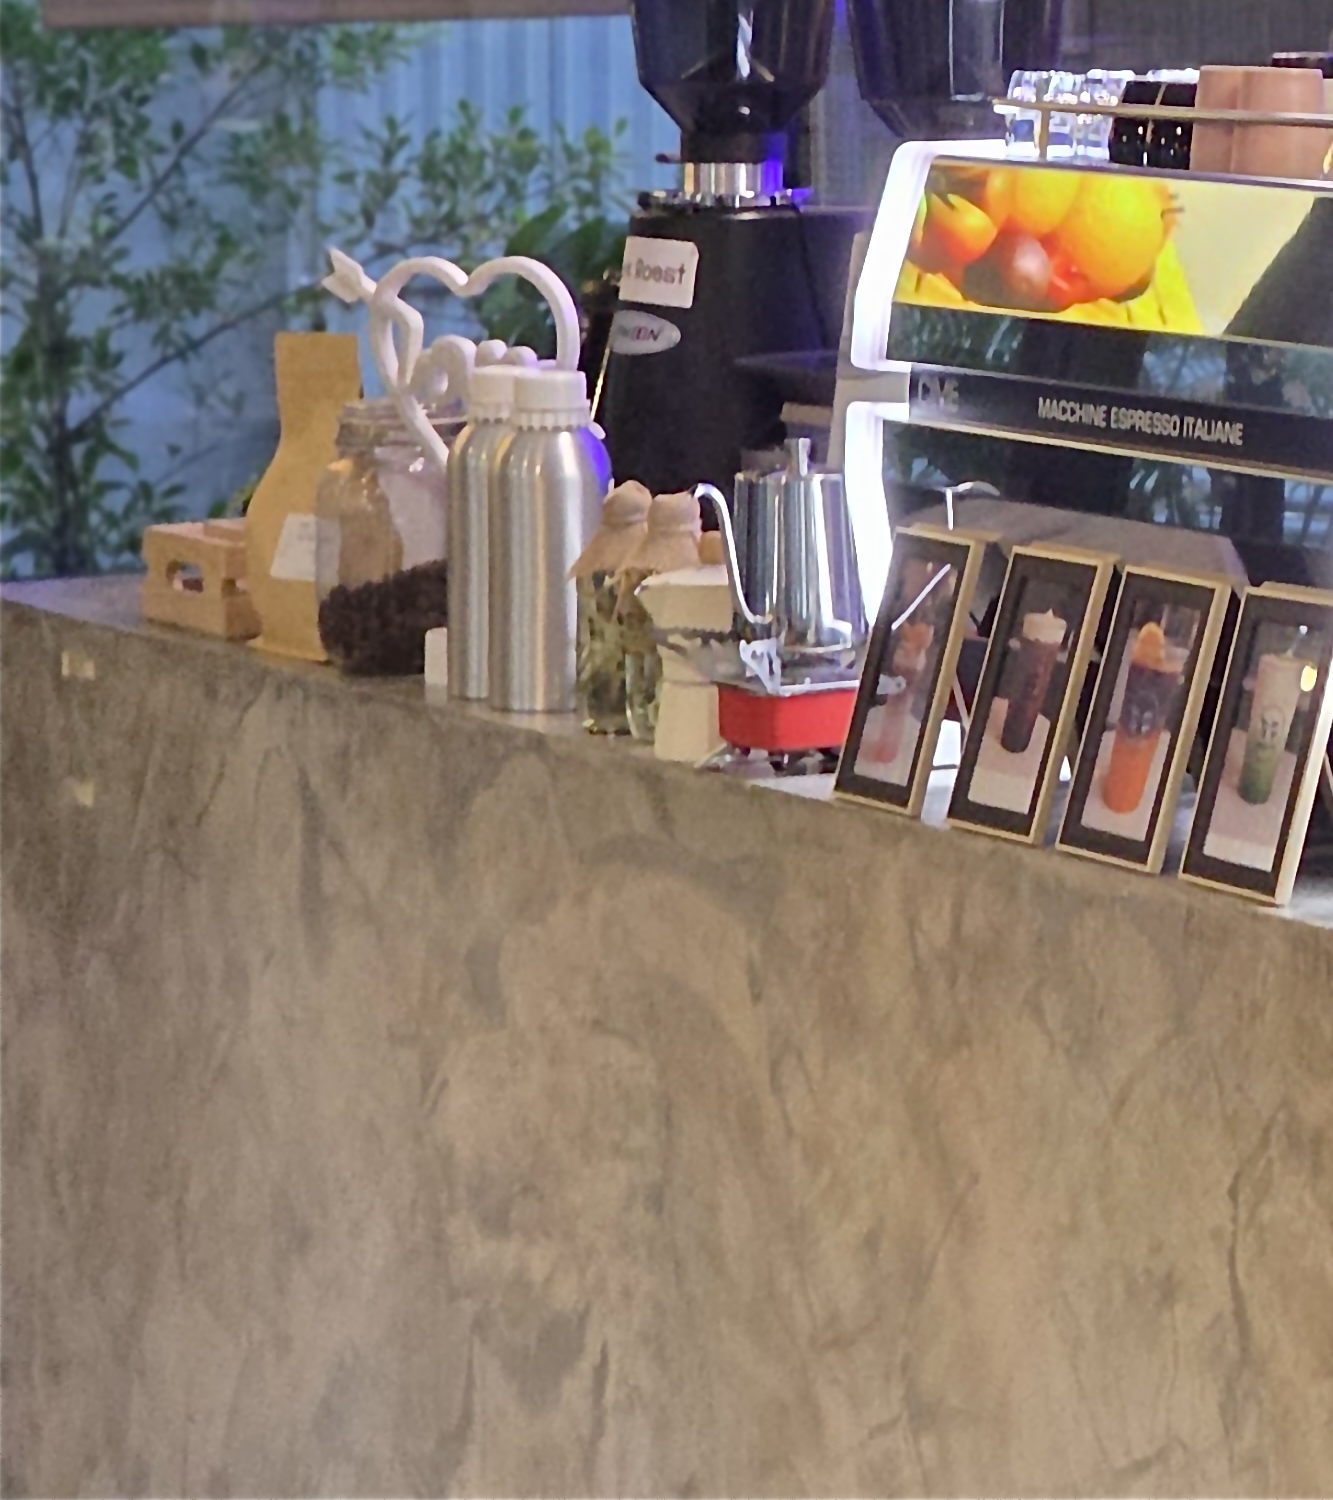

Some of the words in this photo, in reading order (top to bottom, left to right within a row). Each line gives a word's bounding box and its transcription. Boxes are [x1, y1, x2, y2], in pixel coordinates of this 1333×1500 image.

[1037, 397, 1107, 428] MACCHINE
[1110, 406, 1181, 437] ESPRESSO
[1182, 415, 1244, 446] ITALIANE
